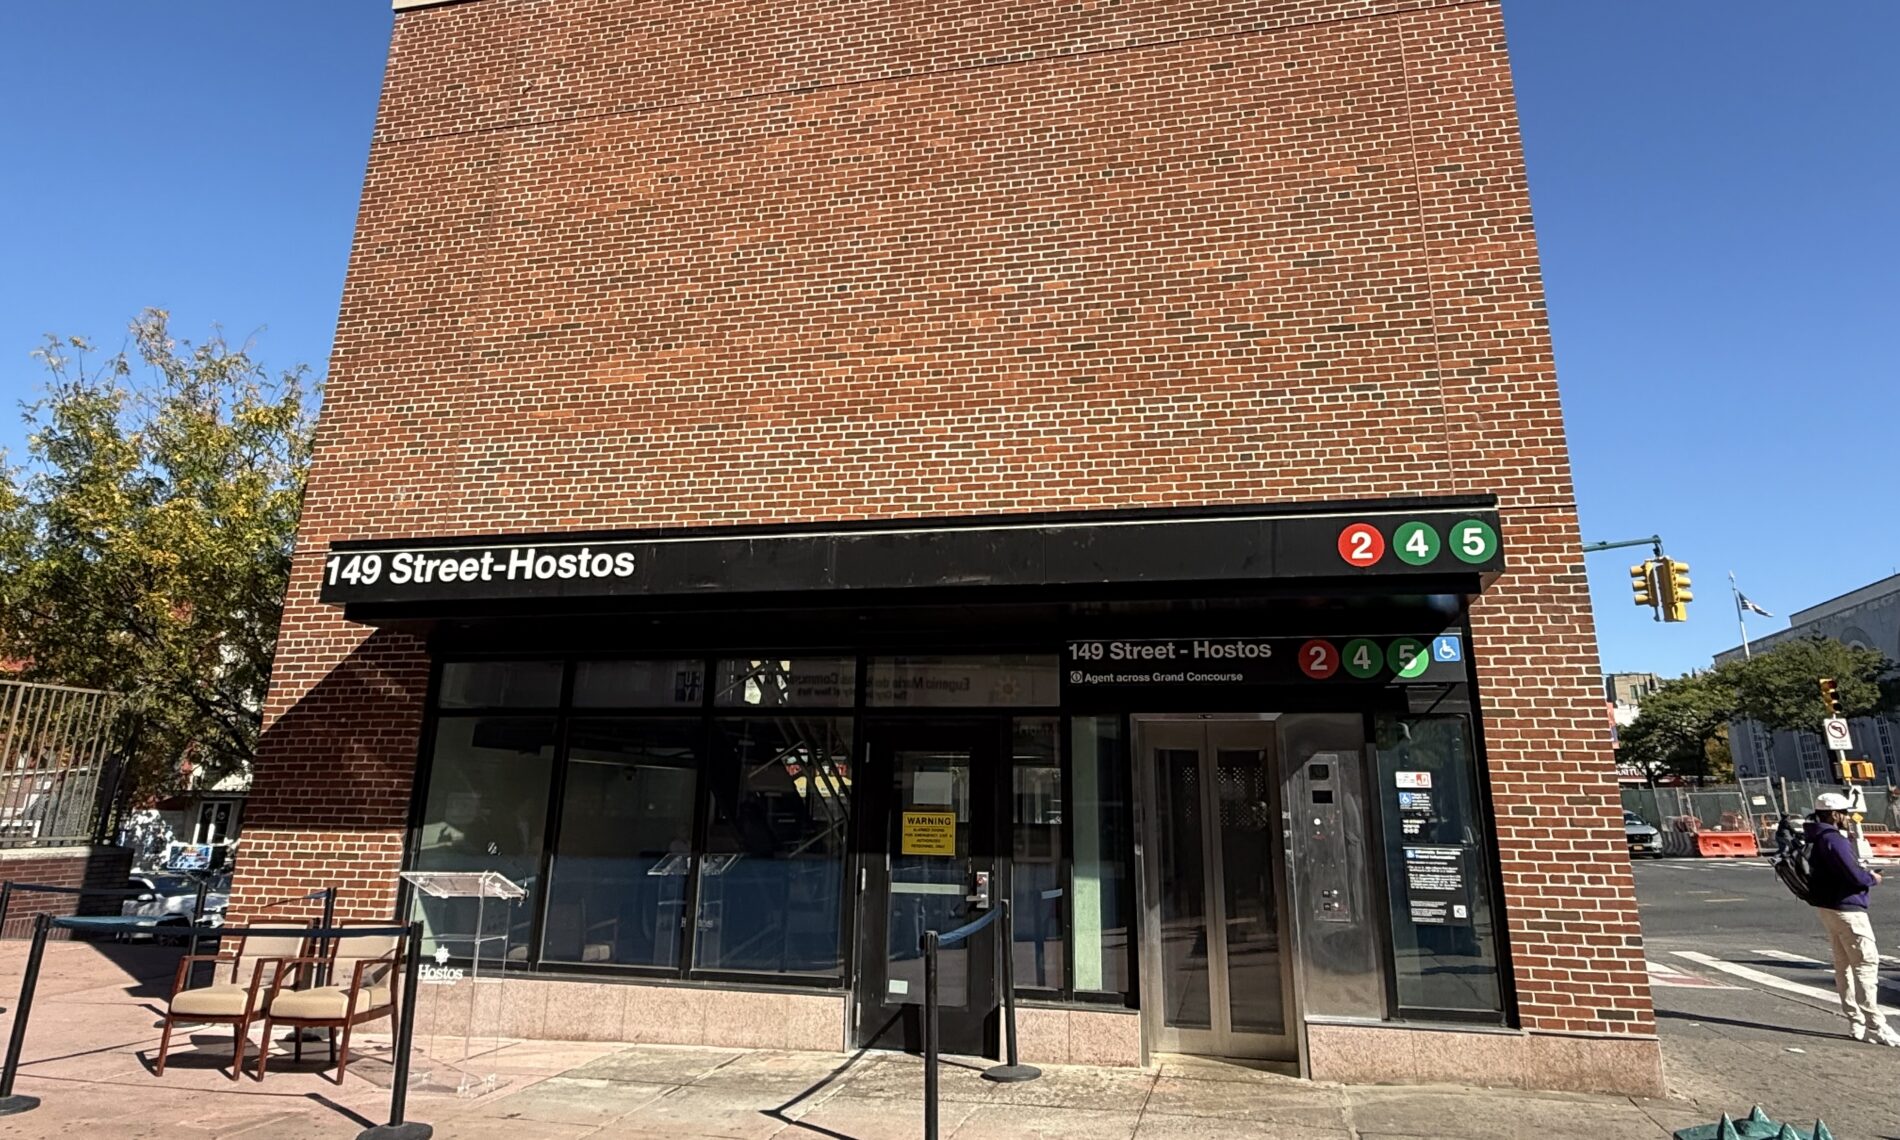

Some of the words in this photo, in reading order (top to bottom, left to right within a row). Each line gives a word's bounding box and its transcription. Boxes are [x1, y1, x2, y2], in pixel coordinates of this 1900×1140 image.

[1350, 531, 1374, 560] 2
[1405, 529, 1429, 558] 4
[1462, 527, 1486, 556] 5
[326, 554, 382, 586] 149
[389, 547, 635, 585] Street-Hostos
[1068, 642, 1104, 660] 149
[1109, 642, 1176, 660] Street
[1193, 640, 1272, 659] Hostos
[1309, 646, 1328, 671] 2
[1352, 645, 1372, 670] 4
[1398, 644, 1418, 670] 5
[1084, 673, 1115, 684] Agent
[1116, 673, 1151, 682] across
[1152, 672, 1184, 682] Grand
[1186, 671, 1244, 682] Concourse
[907, 817, 951, 825] WARNING
[418, 964, 464, 981] Hostos
